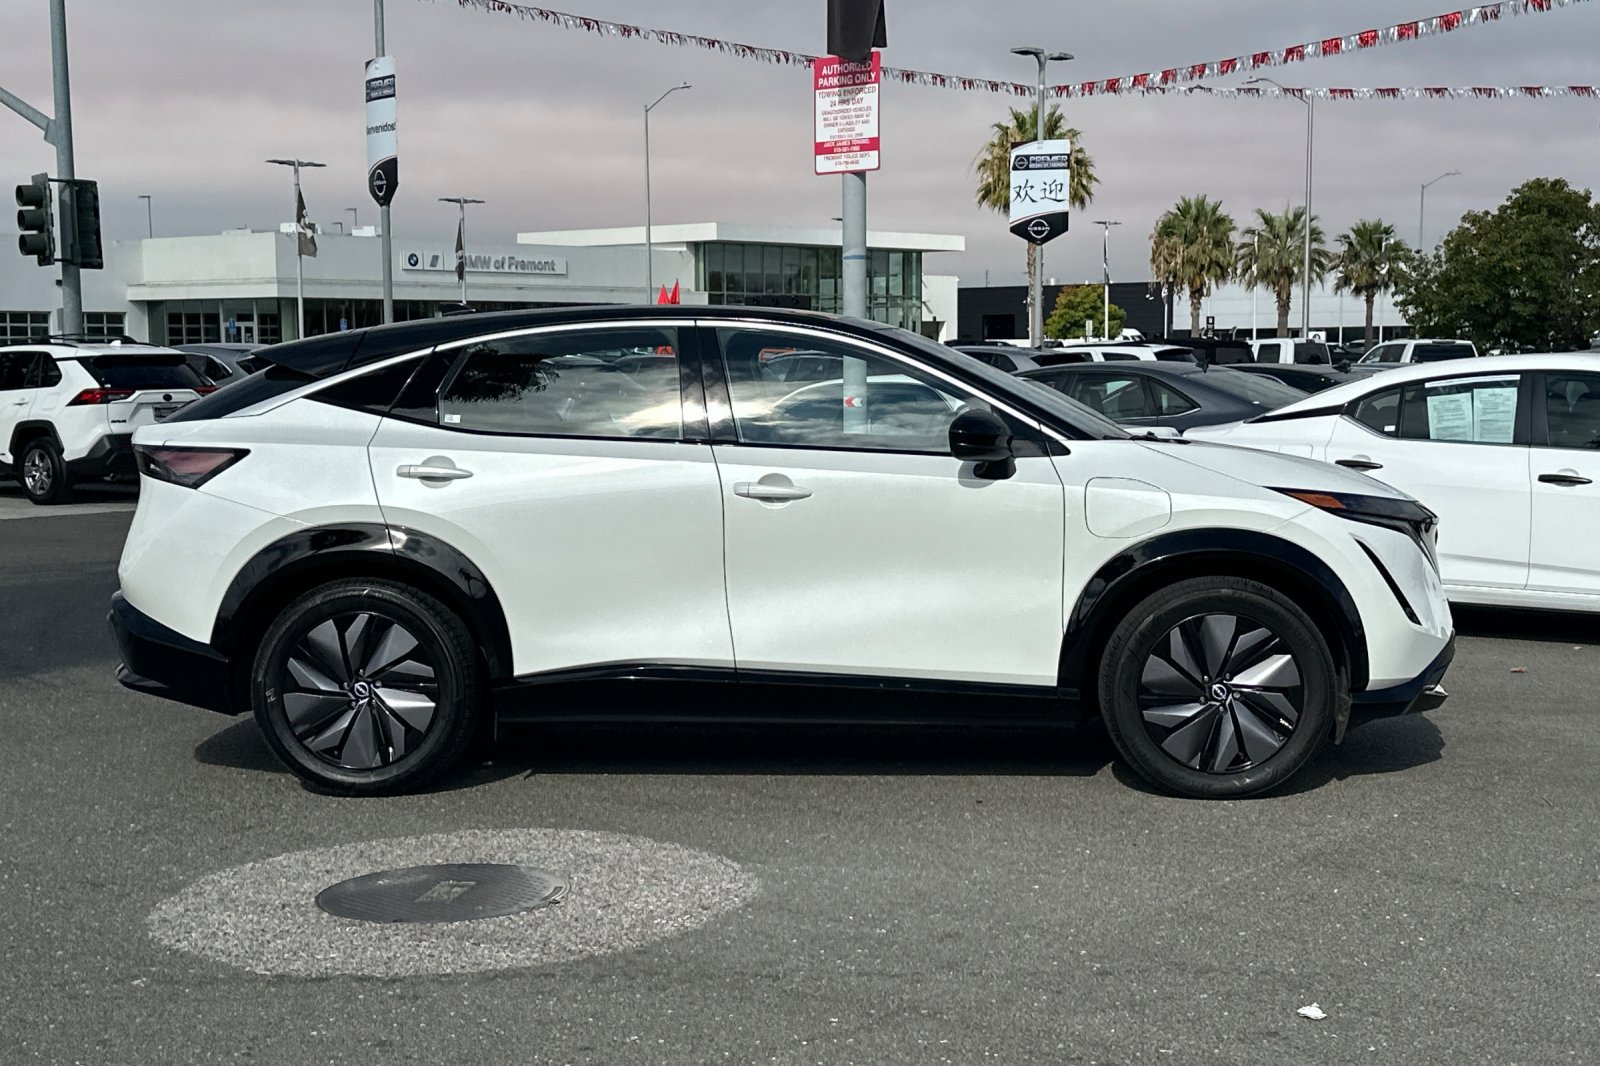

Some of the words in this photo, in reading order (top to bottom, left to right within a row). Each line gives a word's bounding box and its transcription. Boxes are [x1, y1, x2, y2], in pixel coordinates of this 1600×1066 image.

[818, 75, 853, 88] PARKING
[854, 71, 877, 83] ONLY
[818, 89, 842, 99] TOWING
[843, 86, 876, 97] ENFORCED
[851, 97, 864, 105] DAY
[1012, 178, 1067, 203] 欢迎
[493, 256, 505, 270] of
[507, 256, 556, 272] Fremont
